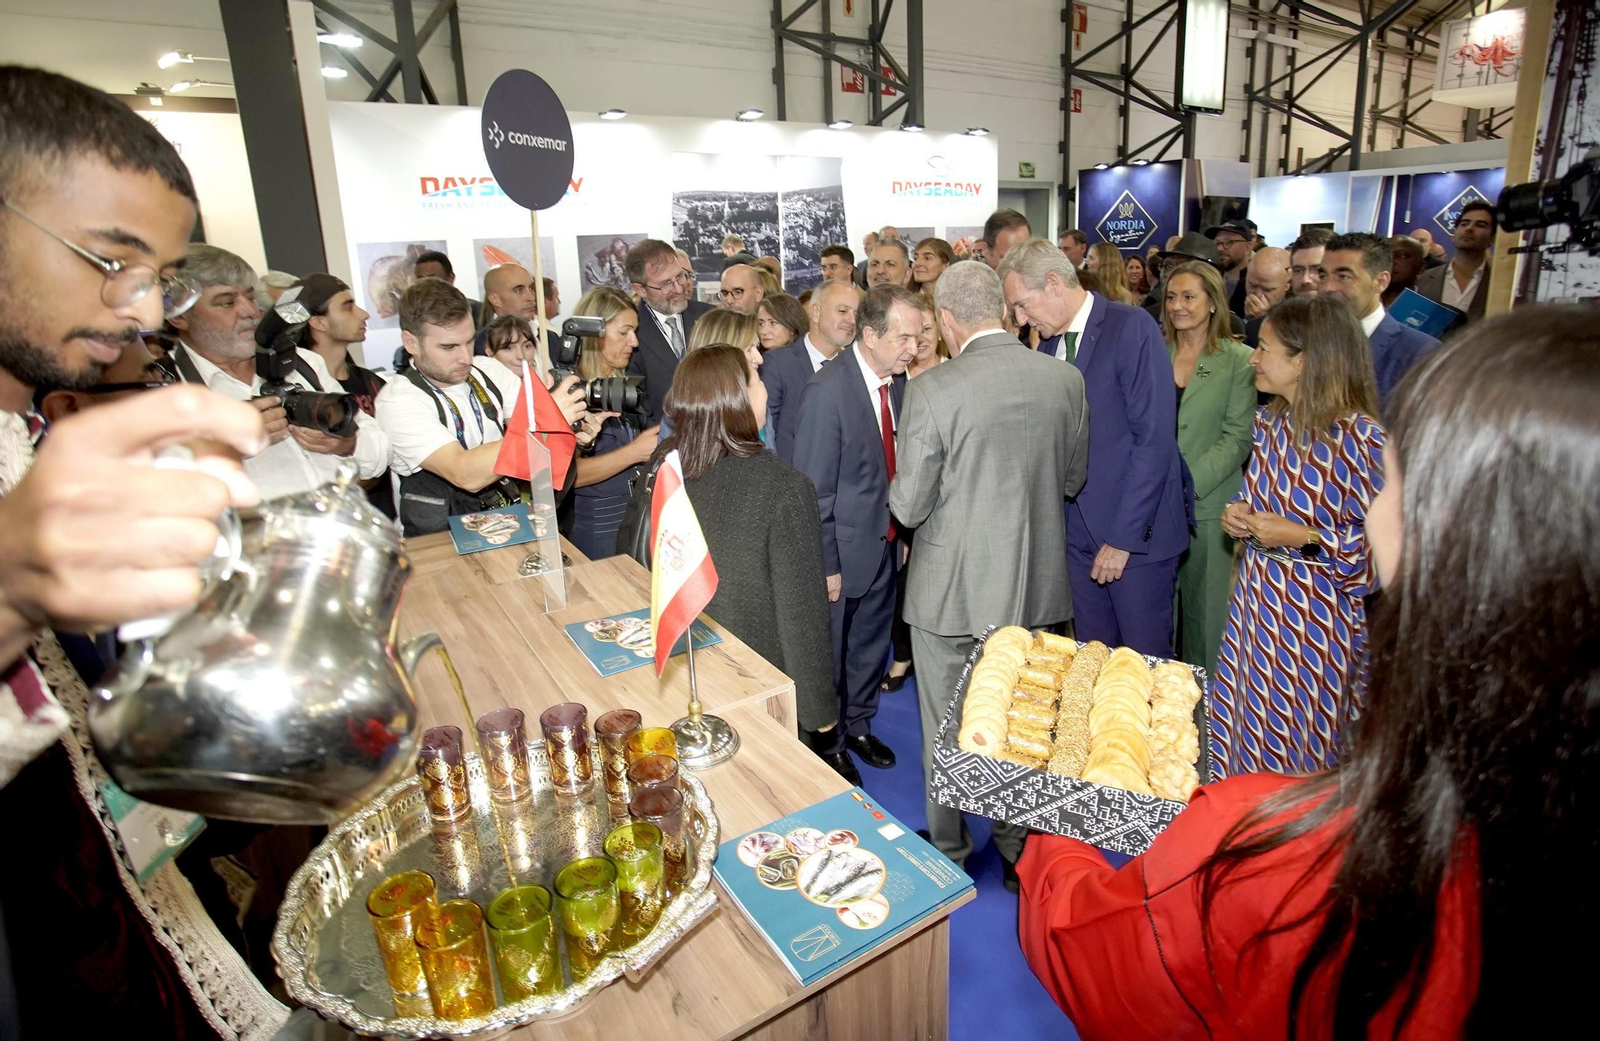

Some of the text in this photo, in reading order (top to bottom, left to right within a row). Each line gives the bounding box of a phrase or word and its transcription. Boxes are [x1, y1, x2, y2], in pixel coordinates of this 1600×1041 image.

[507, 130, 567, 152] conxemar
[420, 176, 583, 197] DAYSY
[892, 181, 982, 197] DAYSEADAY
[1106, 220, 1145, 230] NORDIA
[1109, 230, 1145, 243] Signature
